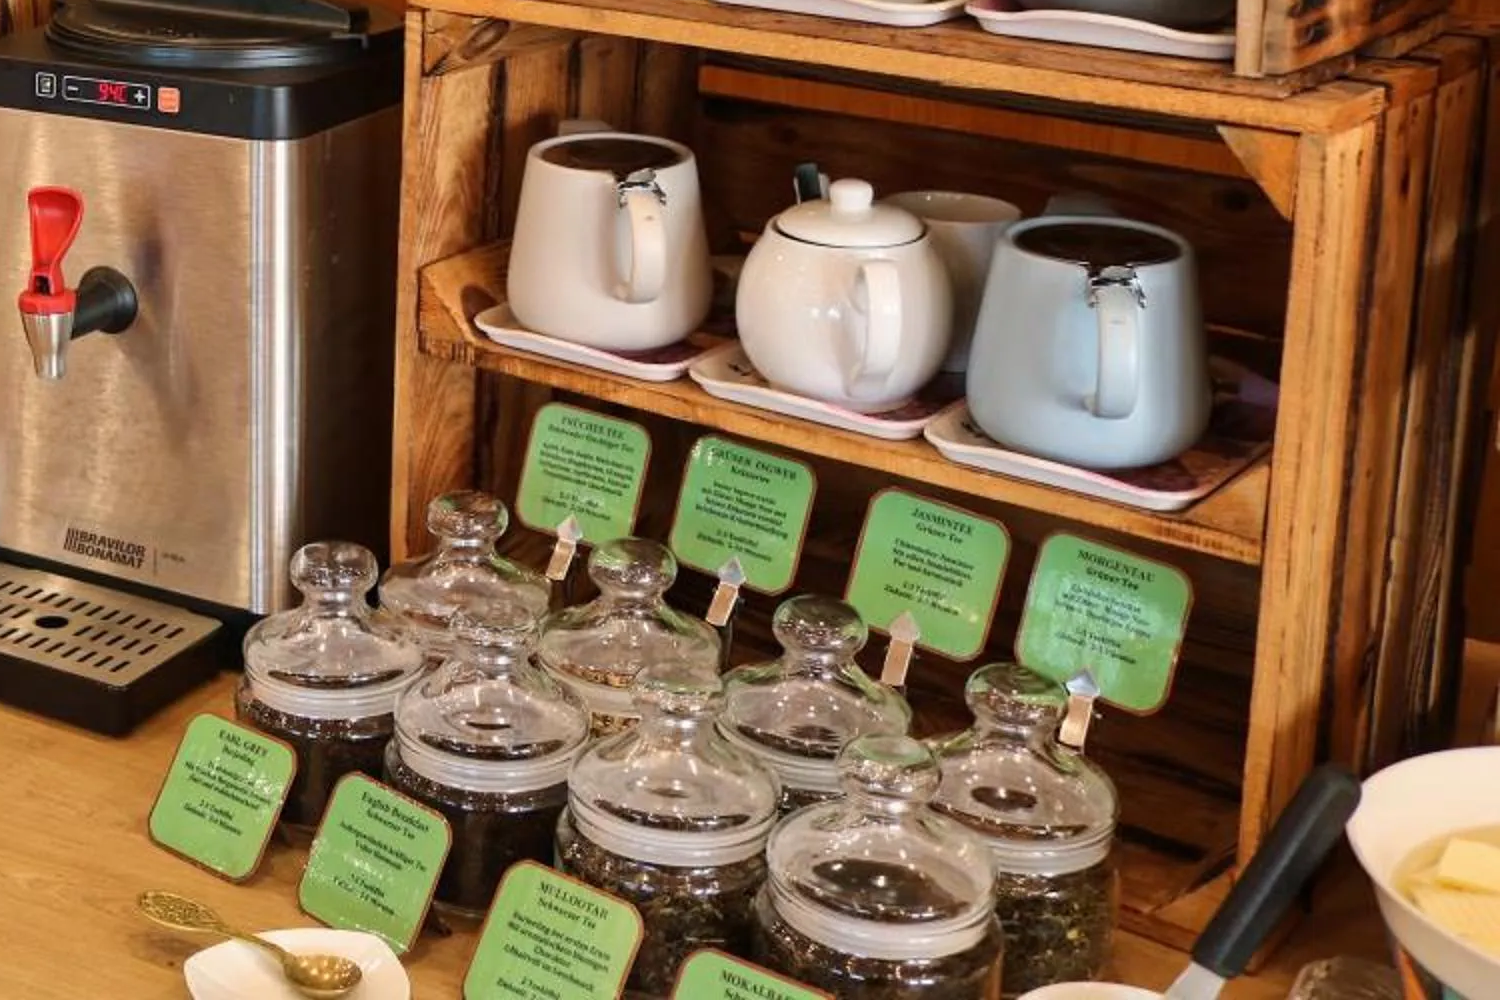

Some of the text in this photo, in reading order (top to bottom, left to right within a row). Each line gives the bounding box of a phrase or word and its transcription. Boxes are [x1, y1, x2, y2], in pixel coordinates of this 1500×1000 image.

[77, 543, 145, 569] BONAMAT
[79, 530, 147, 558] BRAVILOR
[1077, 550, 1156, 583] MORGENTAU
[219, 729, 241, 747] EARL
[361, 791, 390, 813] English
